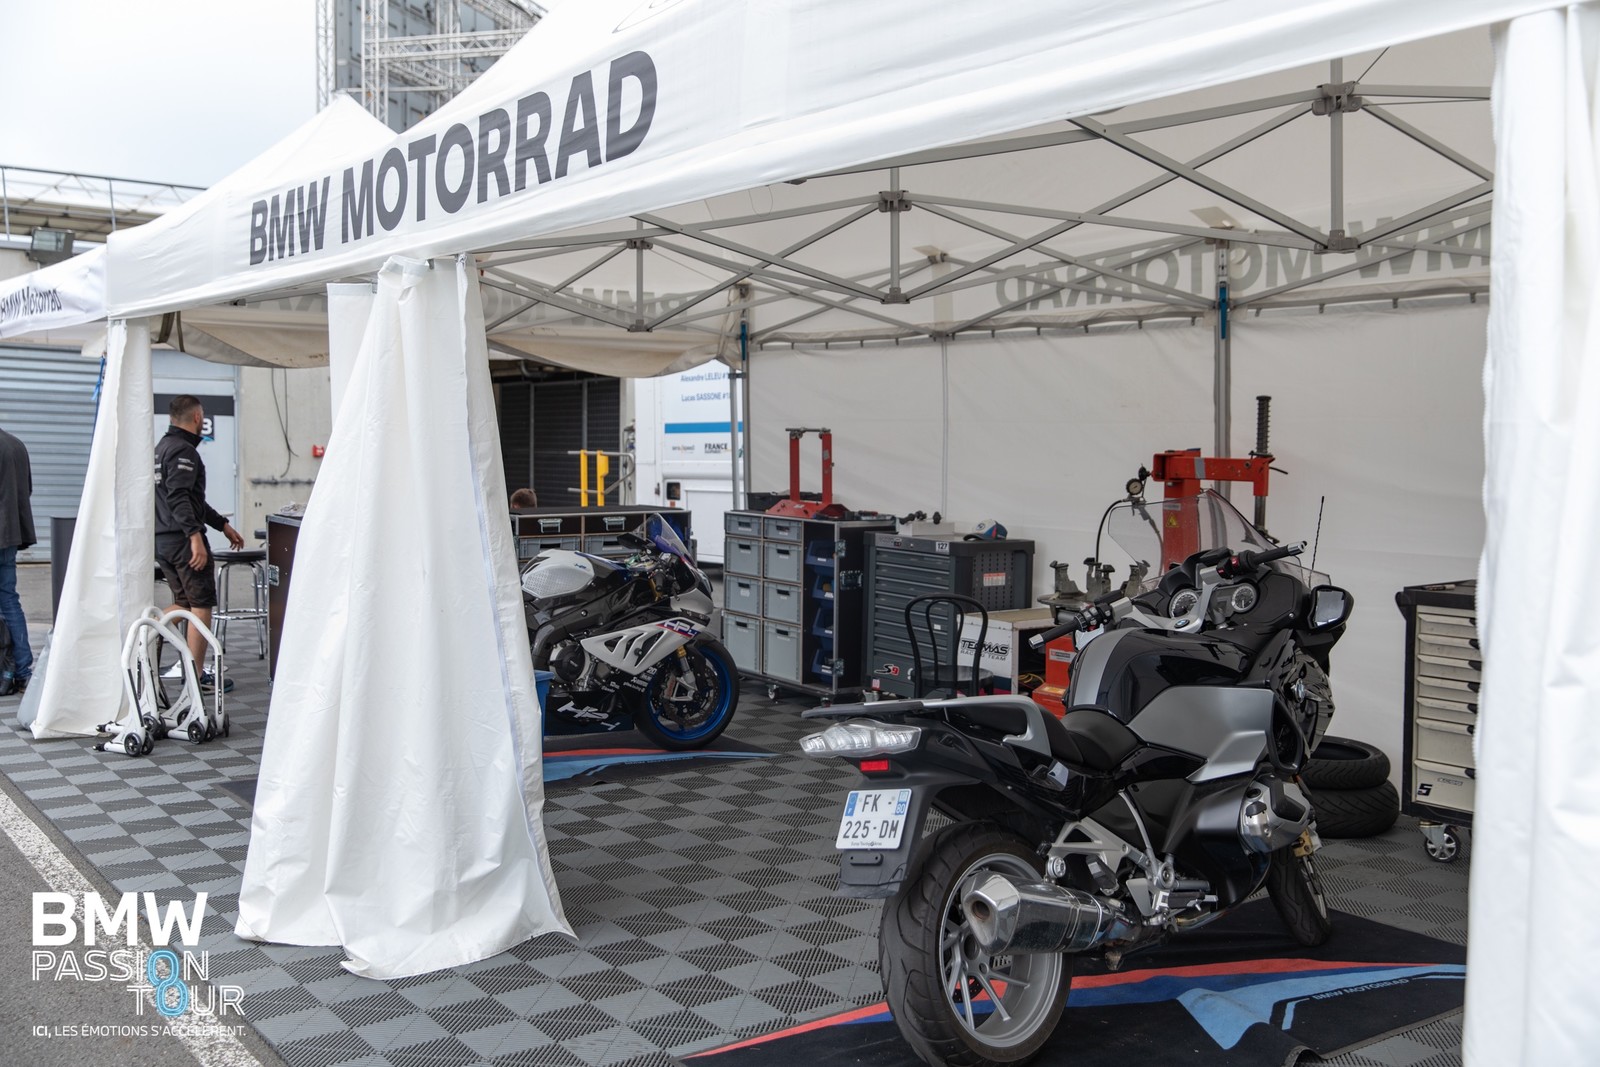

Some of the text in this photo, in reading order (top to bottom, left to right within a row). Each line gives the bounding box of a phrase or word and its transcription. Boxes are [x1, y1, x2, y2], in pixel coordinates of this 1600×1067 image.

[249, 50, 658, 266] BMW MOTORRAD
[937, 542, 949, 550] 127
[861, 794, 882, 813] FK
[1312, 979, 1409, 1000] BMW MOTORRAD
